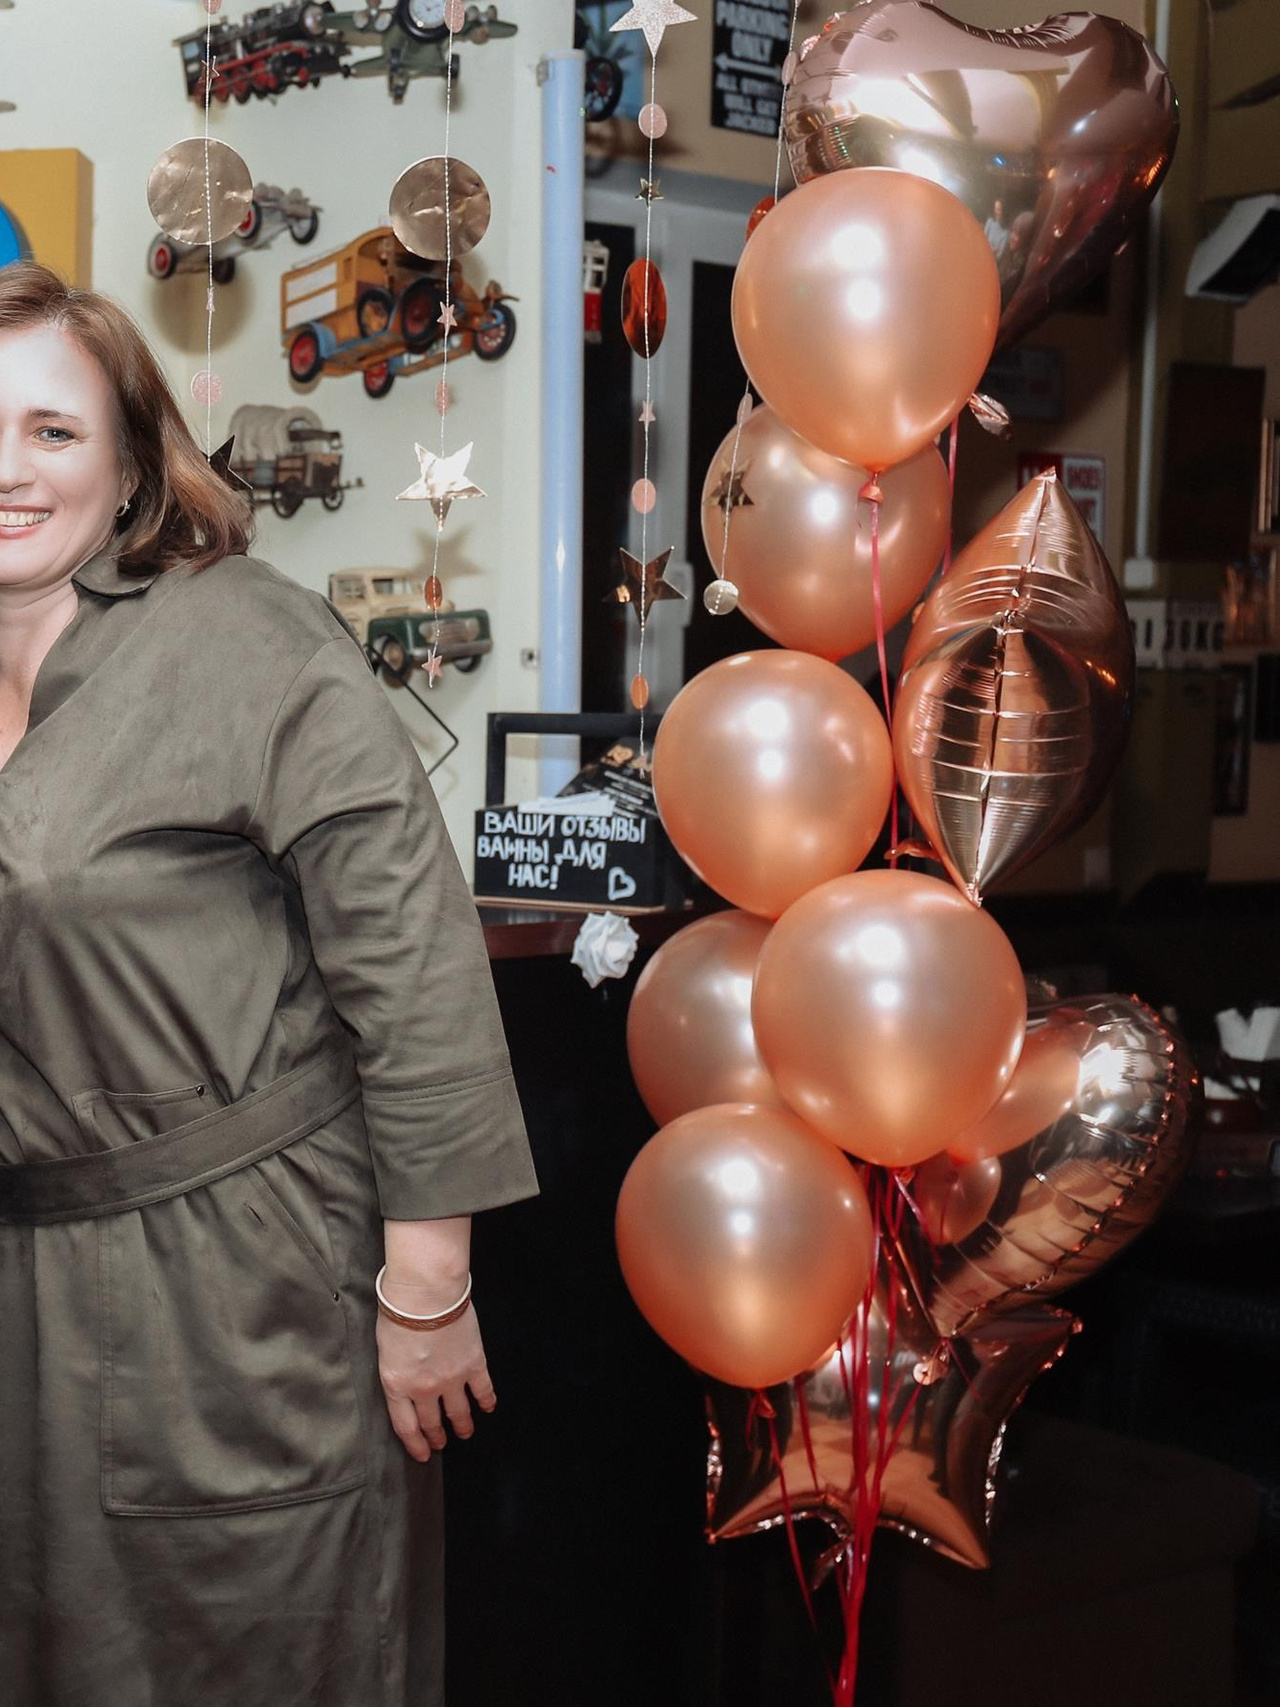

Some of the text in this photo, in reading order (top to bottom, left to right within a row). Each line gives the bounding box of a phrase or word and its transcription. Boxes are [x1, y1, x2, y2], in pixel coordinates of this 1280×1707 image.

[716, 1, 789, 40] PARKING
[731, 29, 773, 62] ONLY
[484, 810, 646, 844] ВАШИ ОТЗЫВЫ
[477, 835, 607, 870] ВАЖНЫ ДЛЯ
[508, 862, 559, 890] НАС!
